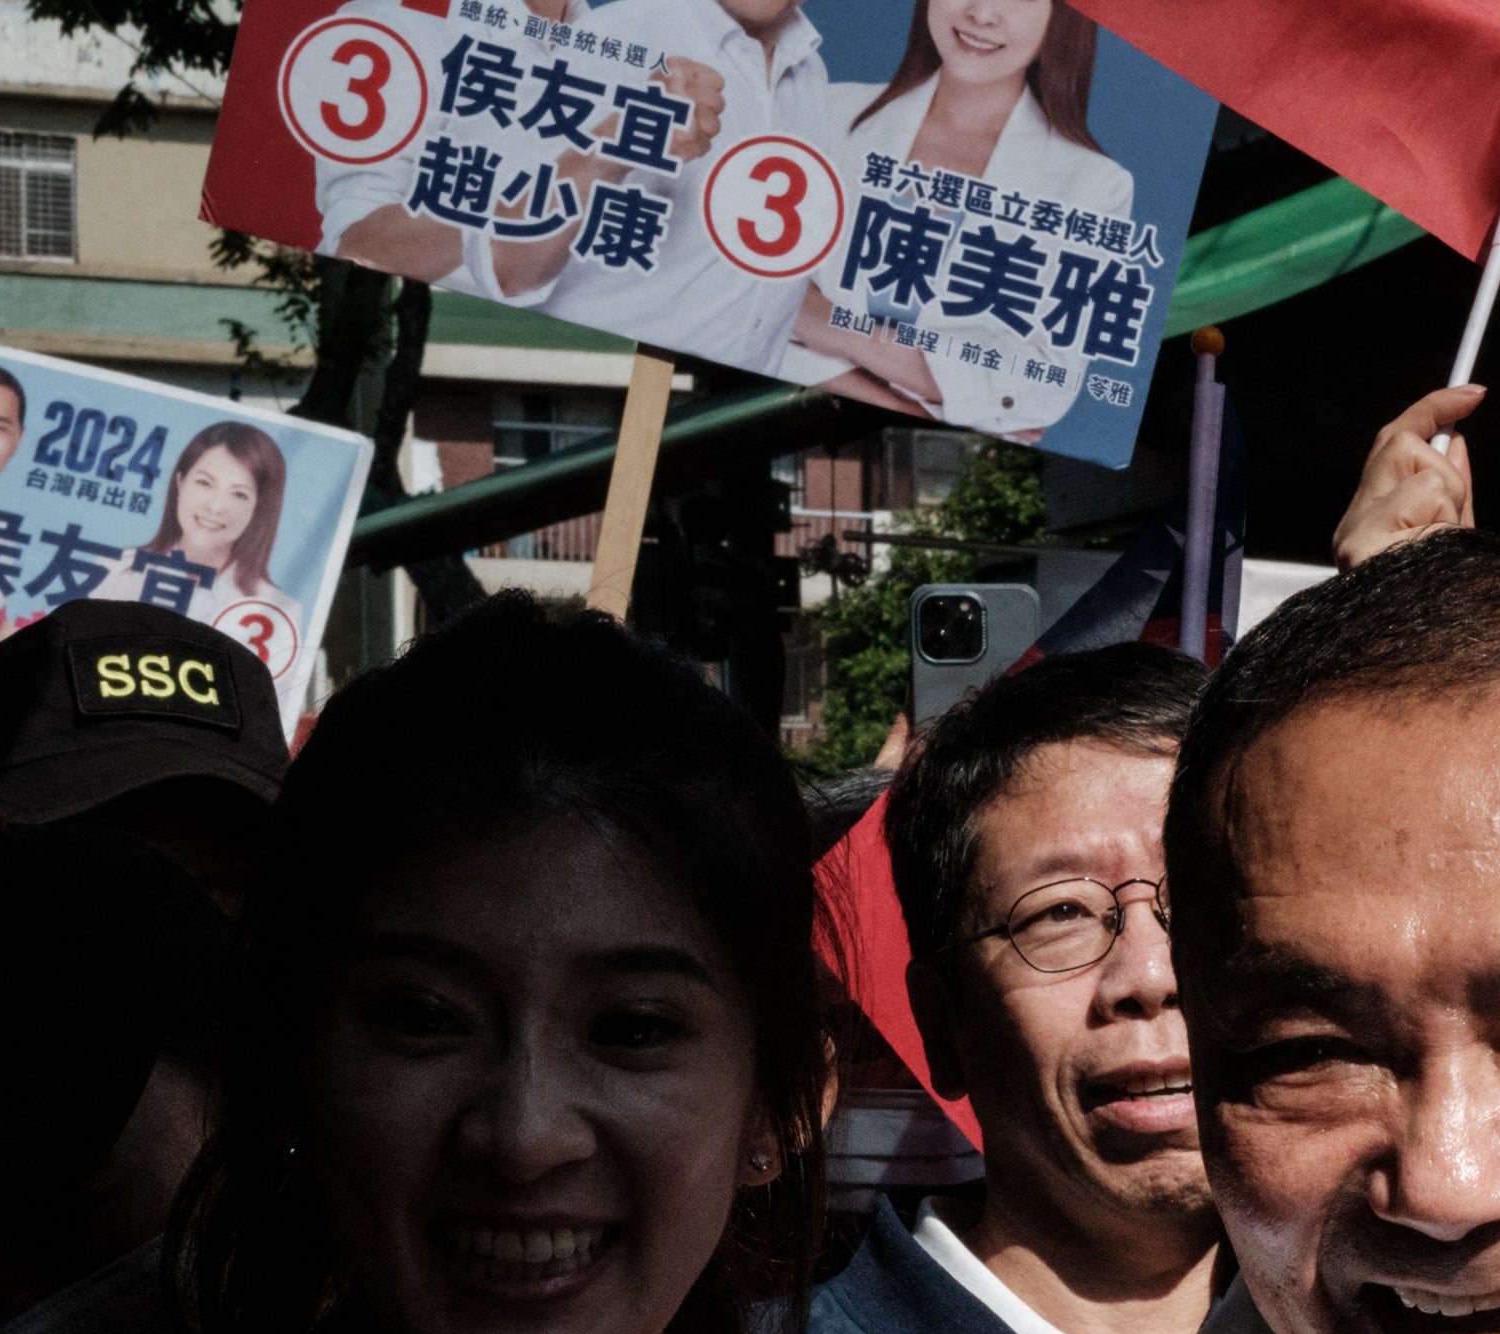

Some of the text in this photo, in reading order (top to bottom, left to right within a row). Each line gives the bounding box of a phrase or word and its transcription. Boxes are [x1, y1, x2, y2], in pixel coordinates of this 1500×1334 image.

[320, 39, 392, 141] 3
[439, 34, 692, 174] 侯友宜
[407, 136, 670, 273] 趙少康
[736, 156, 809, 258] 3
[861, 151, 1164, 267] 第六選區立委候選人
[839, 194, 1152, 367] 陳美雅
[830, 305, 874, 336] 鼓山
[958, 342, 1003, 371] 前金
[1023, 359, 1068, 388] 新興
[1087, 375, 1133, 405] 苓雅
[33, 400, 170, 490] 2024
[97, 653, 219, 706] SSC
[239, 614, 275, 667] 3
